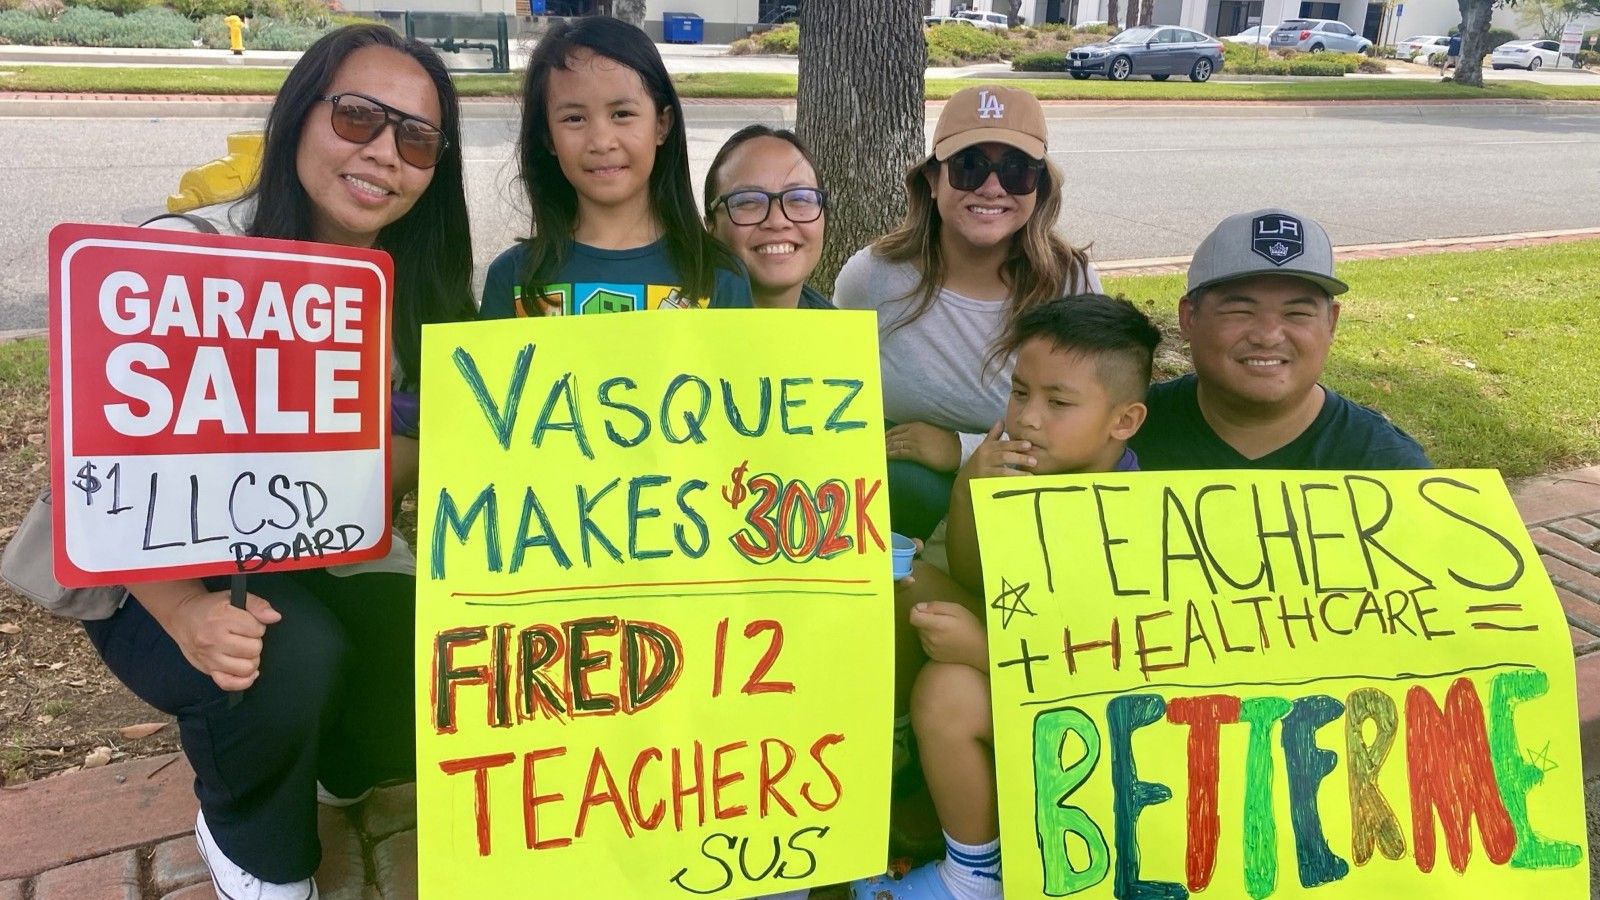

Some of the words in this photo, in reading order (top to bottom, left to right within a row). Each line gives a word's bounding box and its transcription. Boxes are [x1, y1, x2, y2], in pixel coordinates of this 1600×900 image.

[977, 90, 1004, 118] LA
[1258, 219, 1298, 236] LA
[98, 271, 363, 344] GARAGE
[103, 342, 362, 437] SALE
[451, 343, 868, 461] VASQUEZ
[72, 460, 134, 515] $1
[430, 474, 710, 581] MAKES
[721, 460, 887, 566] $302K
[229, 524, 365, 572] BOARD
[991, 475, 1526, 602] TEACHERS
[430, 615, 685, 735] FIRED
[711, 617, 796, 698] 12
[1062, 586, 1456, 681] HEALTHCARE
[439, 733, 846, 857] TEACHERS
[669, 826, 831, 895] SUS
